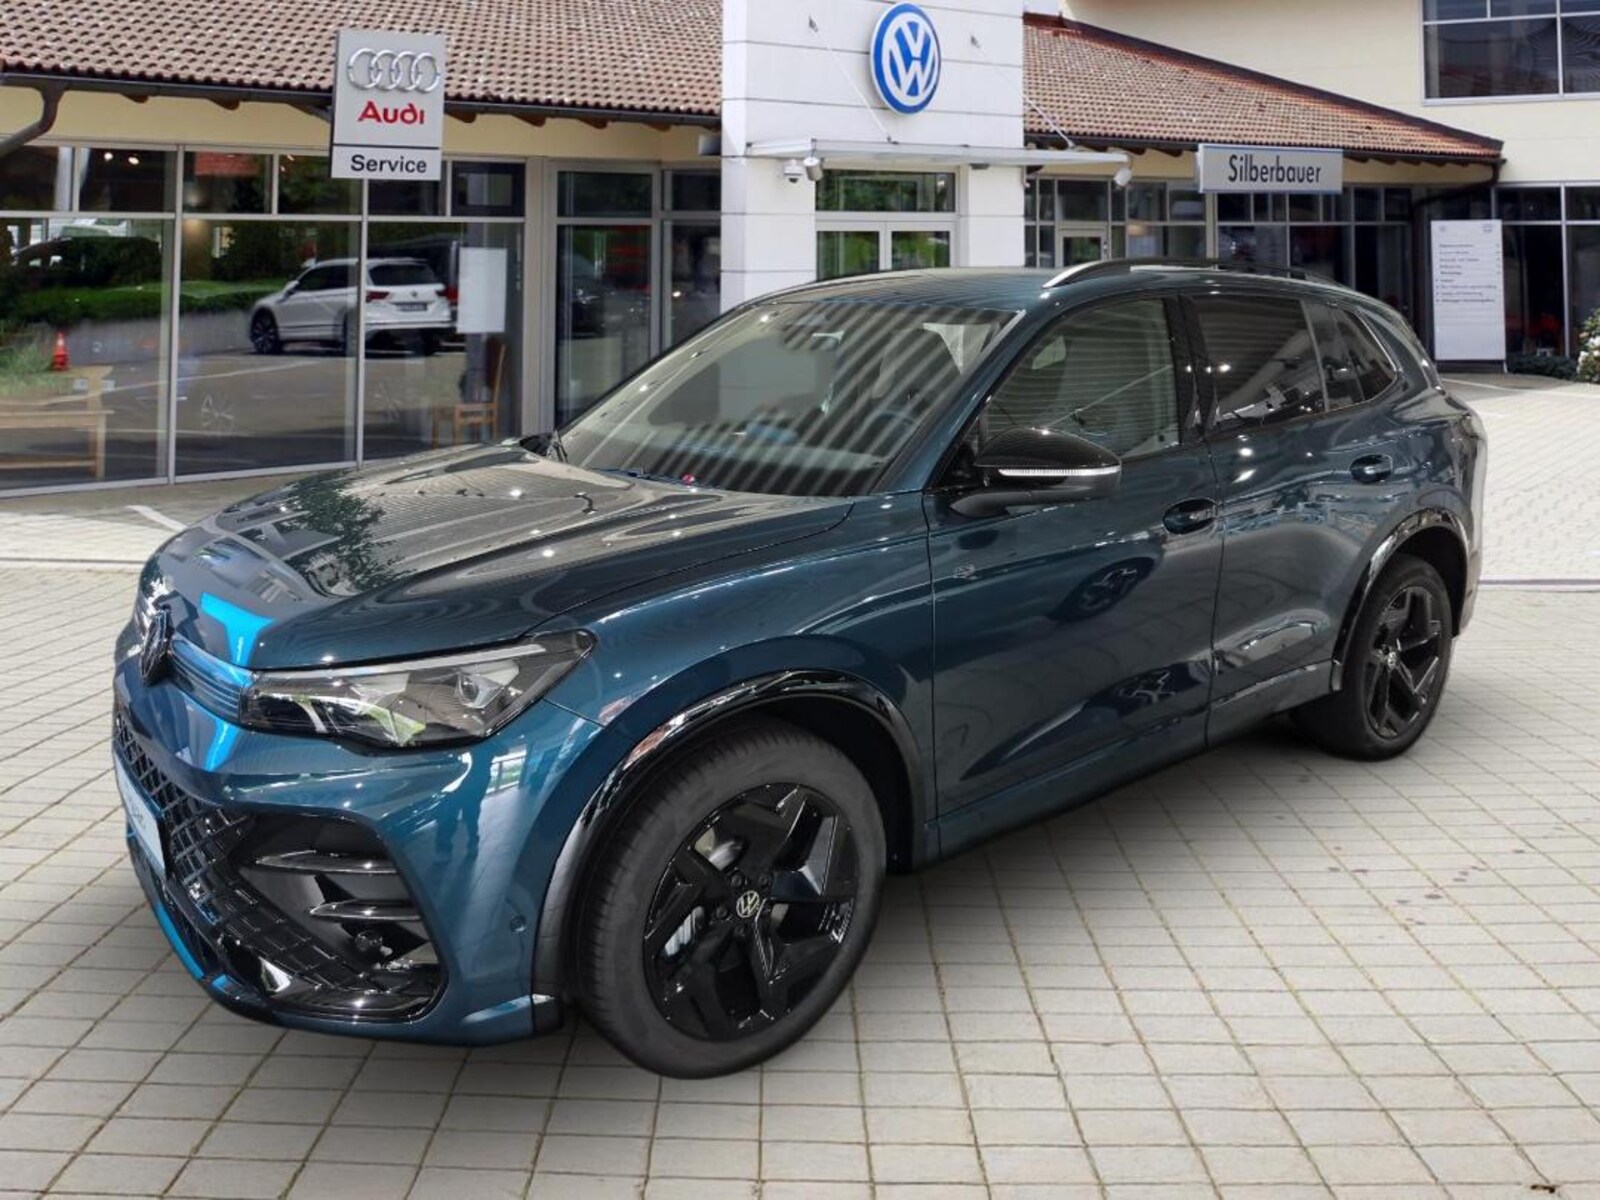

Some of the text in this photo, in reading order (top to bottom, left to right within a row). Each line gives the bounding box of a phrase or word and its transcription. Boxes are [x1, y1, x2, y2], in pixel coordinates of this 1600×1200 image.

[879, 9, 938, 108] VW
[357, 100, 425, 125] Audi
[350, 153, 427, 173] Service
[1228, 154, 1321, 183] Silberbauer
